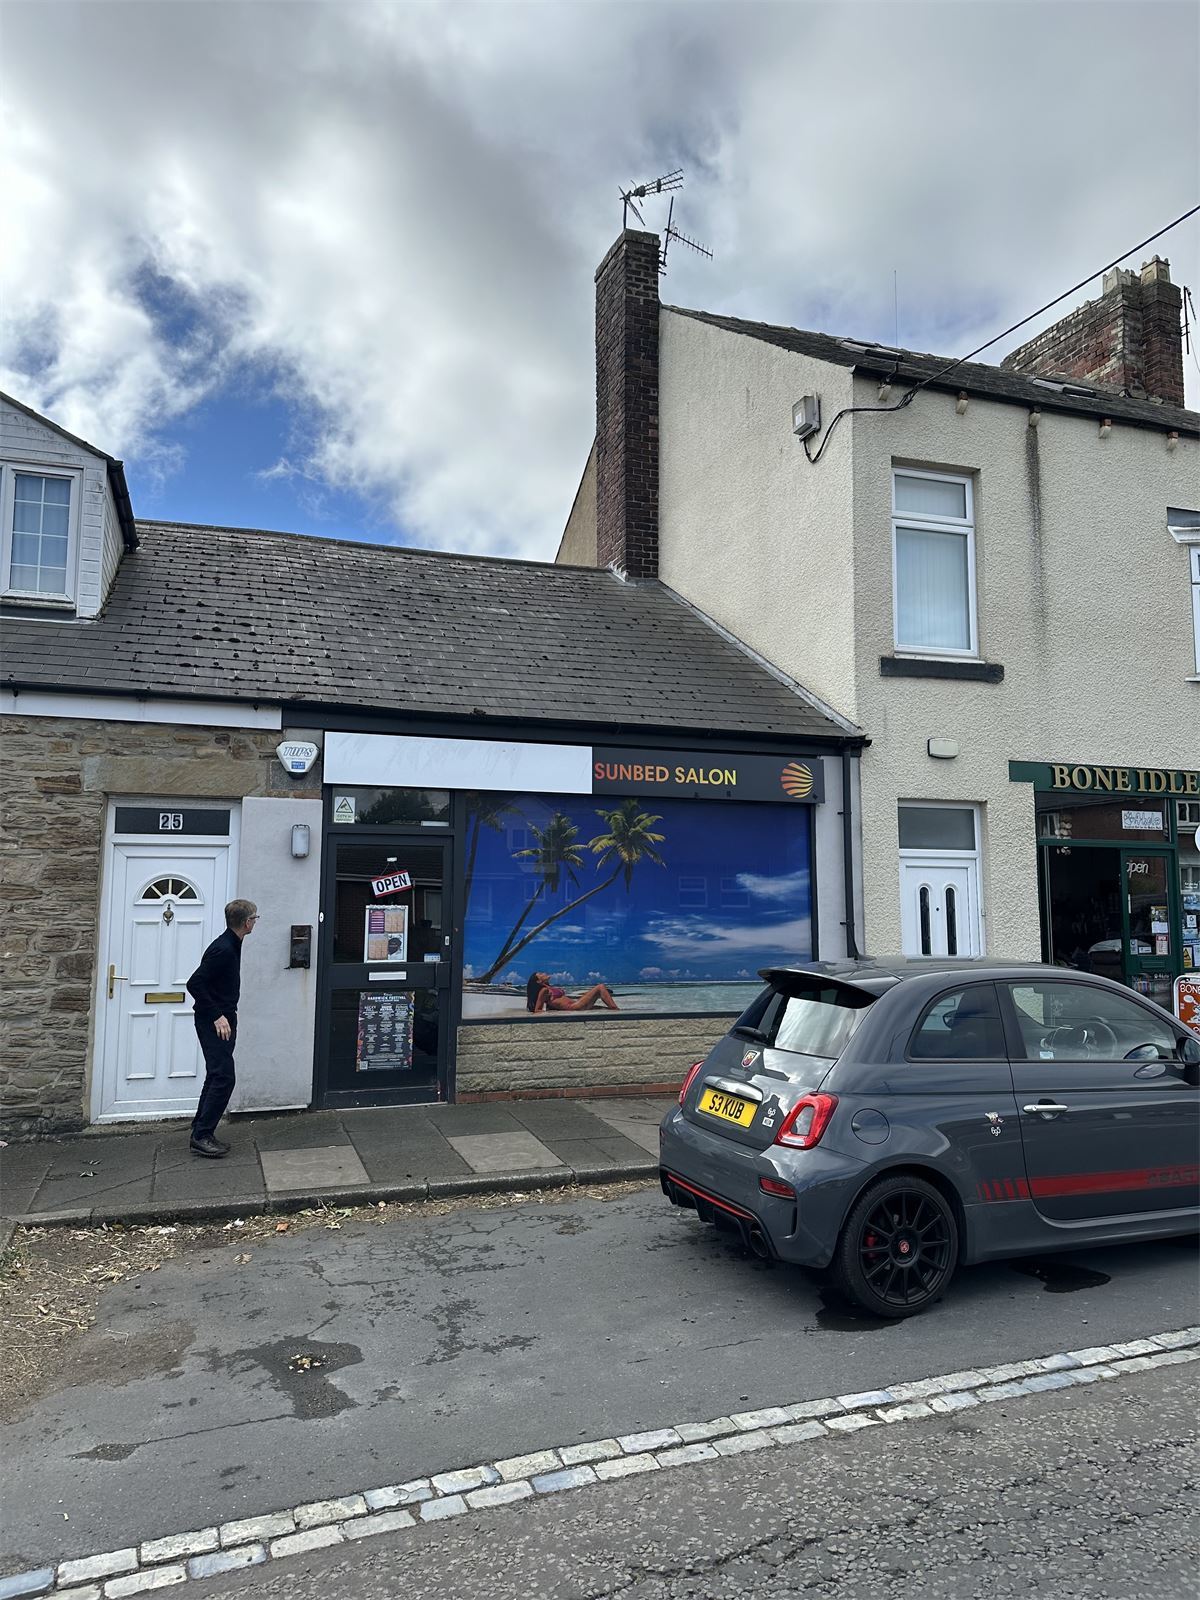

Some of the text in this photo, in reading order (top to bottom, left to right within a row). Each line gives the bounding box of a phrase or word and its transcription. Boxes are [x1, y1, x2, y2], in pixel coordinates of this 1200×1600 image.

[283, 746, 314, 757] TOPS
[594, 763, 737, 785] SUNBED SALON
[1051, 765, 1200, 794] BONE IDLE
[161, 814, 181, 828] 25
[376, 874, 408, 892] OPEN
[709, 1094, 745, 1119] S3 KUB
